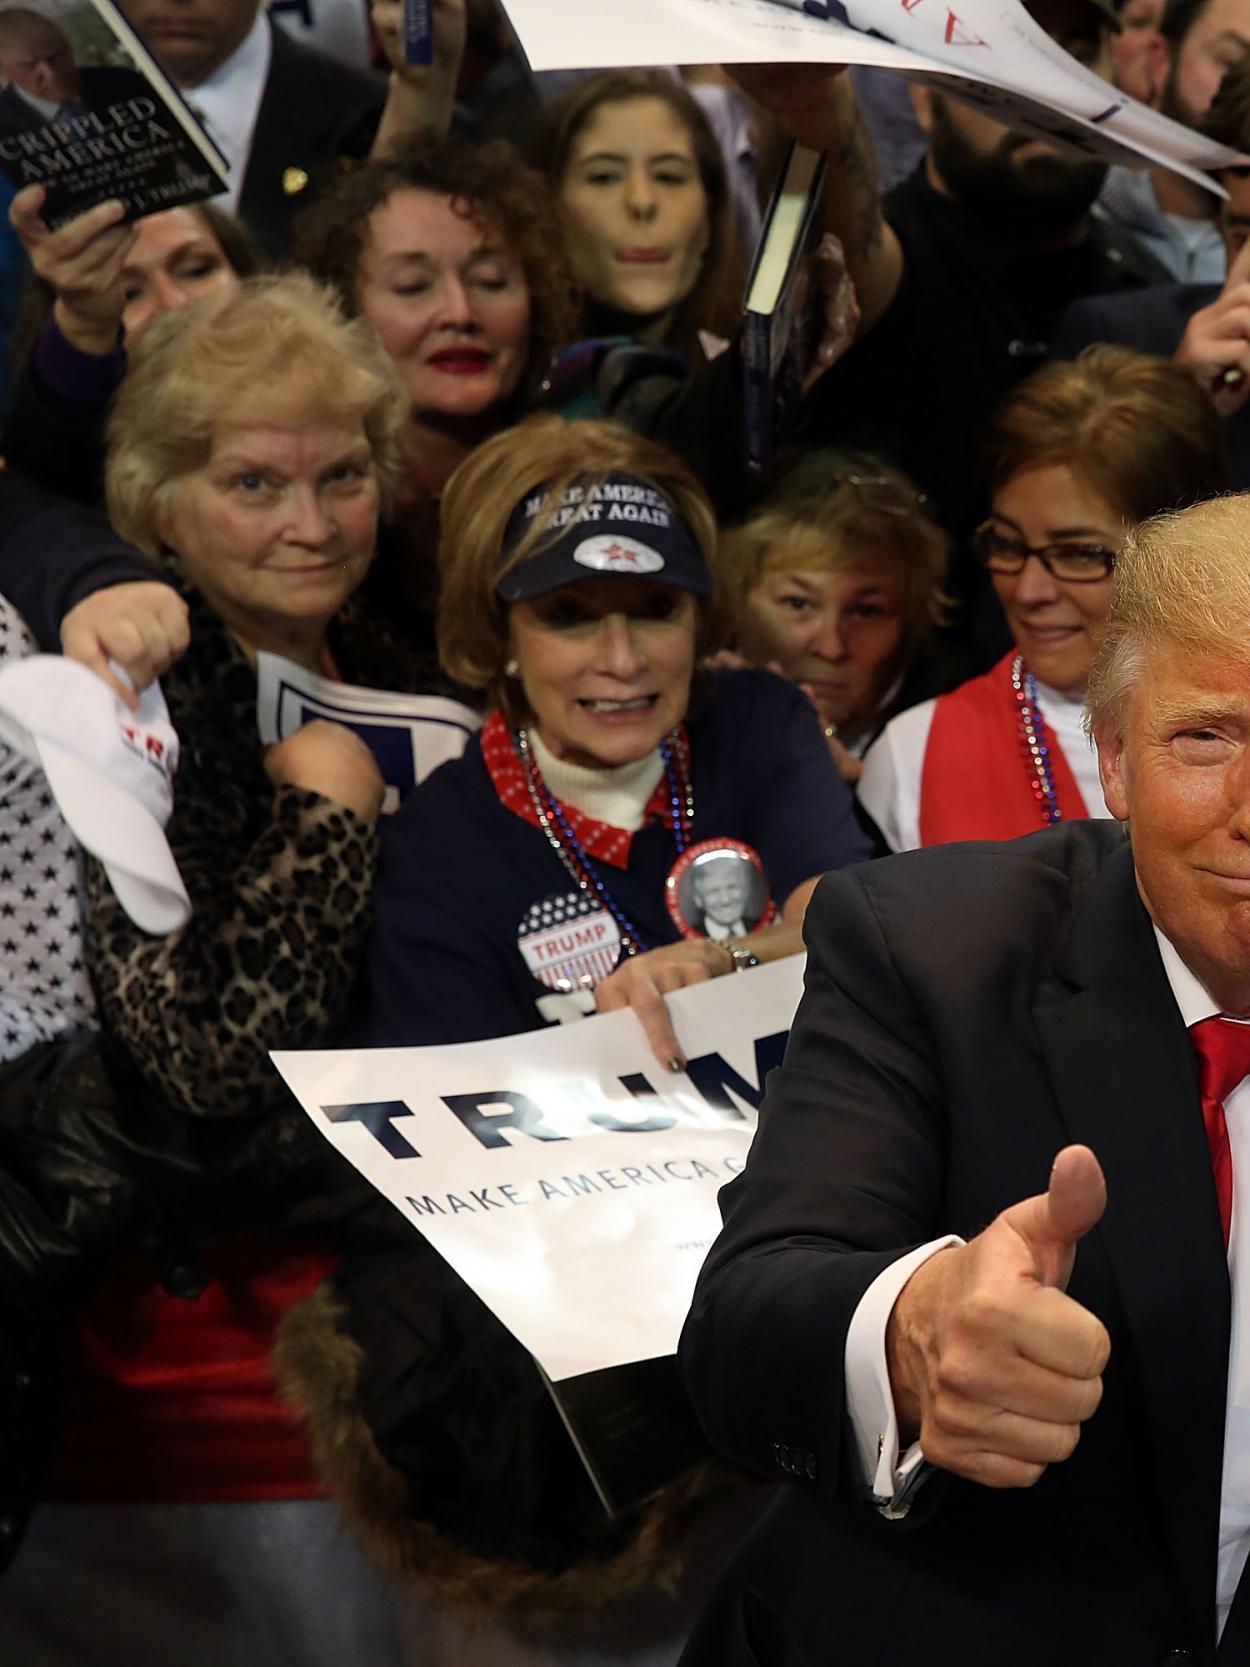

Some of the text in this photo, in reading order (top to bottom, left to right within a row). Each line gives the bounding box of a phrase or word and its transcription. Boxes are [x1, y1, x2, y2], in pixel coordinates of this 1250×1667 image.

[0, 96, 157, 160] CRIPPLED
[20, 119, 171, 179] AMERICA
[607, 501, 672, 528] AGAIN
[534, 923, 607, 962] TRUMP
[404, 1182, 530, 1217] MAKE
[536, 1159, 719, 1201] AMERICA
